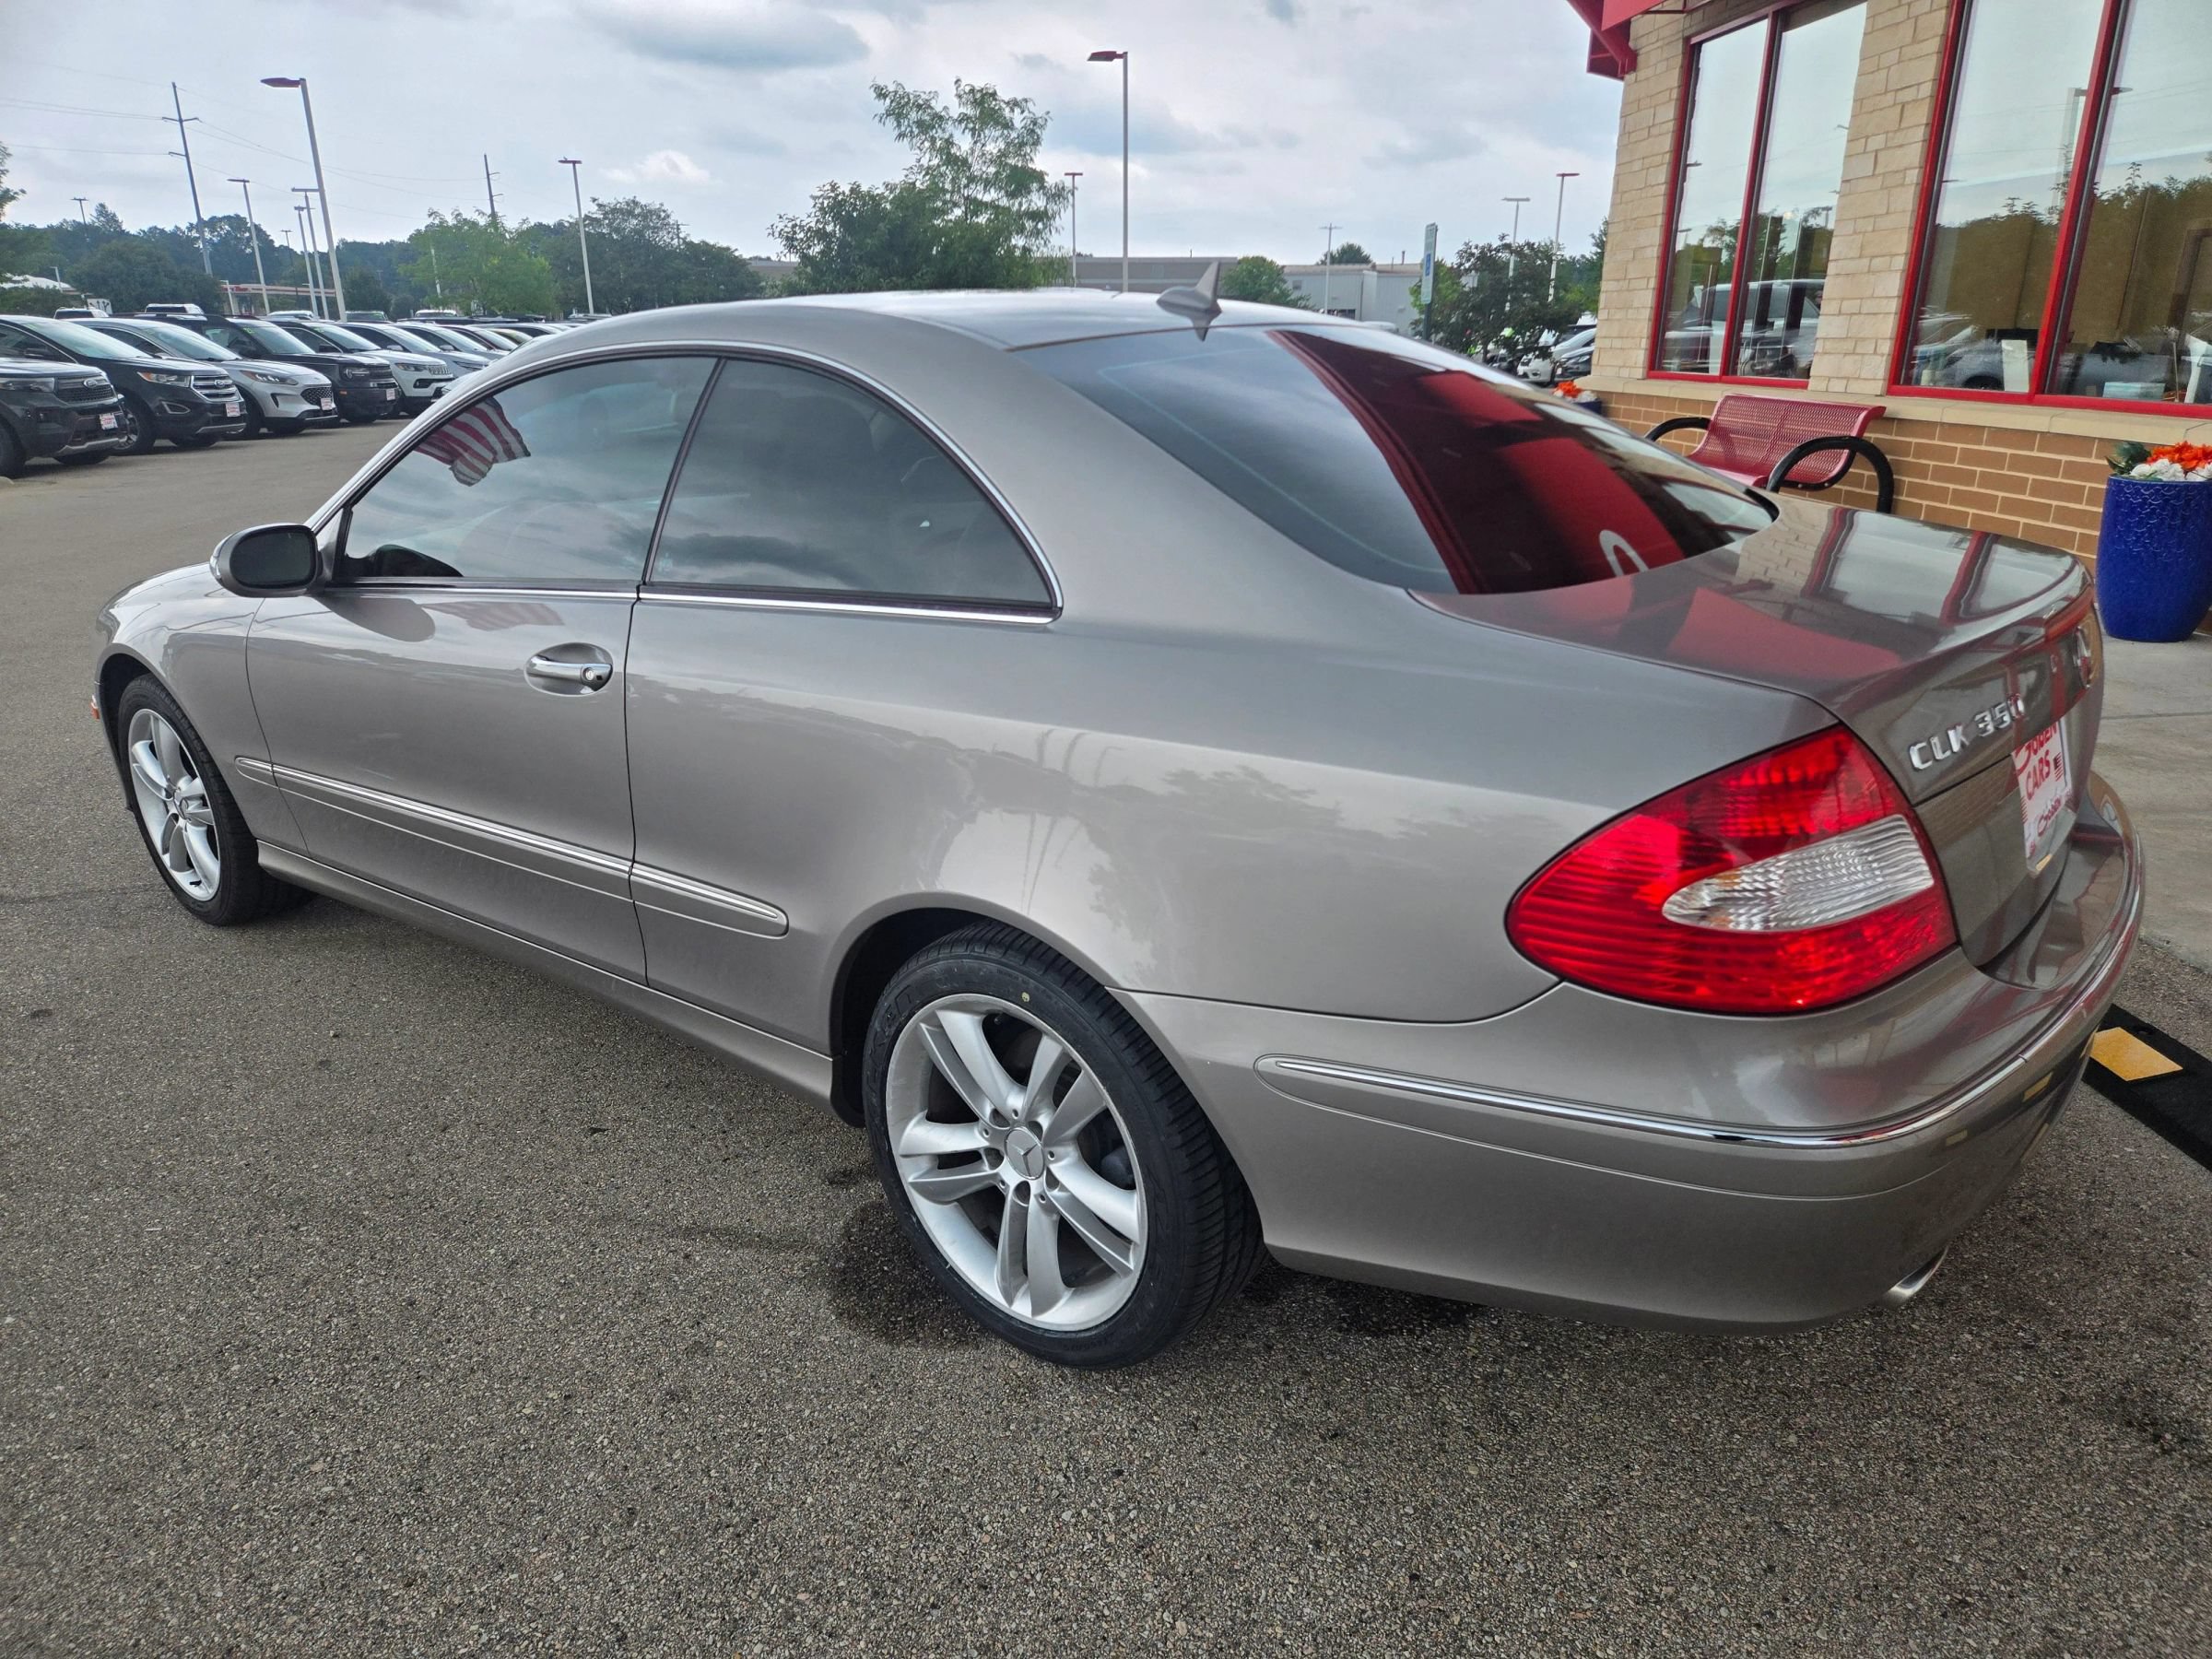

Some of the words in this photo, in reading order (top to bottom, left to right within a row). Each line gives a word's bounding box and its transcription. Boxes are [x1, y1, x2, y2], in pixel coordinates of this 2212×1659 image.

[1909, 724, 1969, 771] CLK
[1974, 693, 2025, 737] 350
[2026, 749, 2051, 801] CARS
